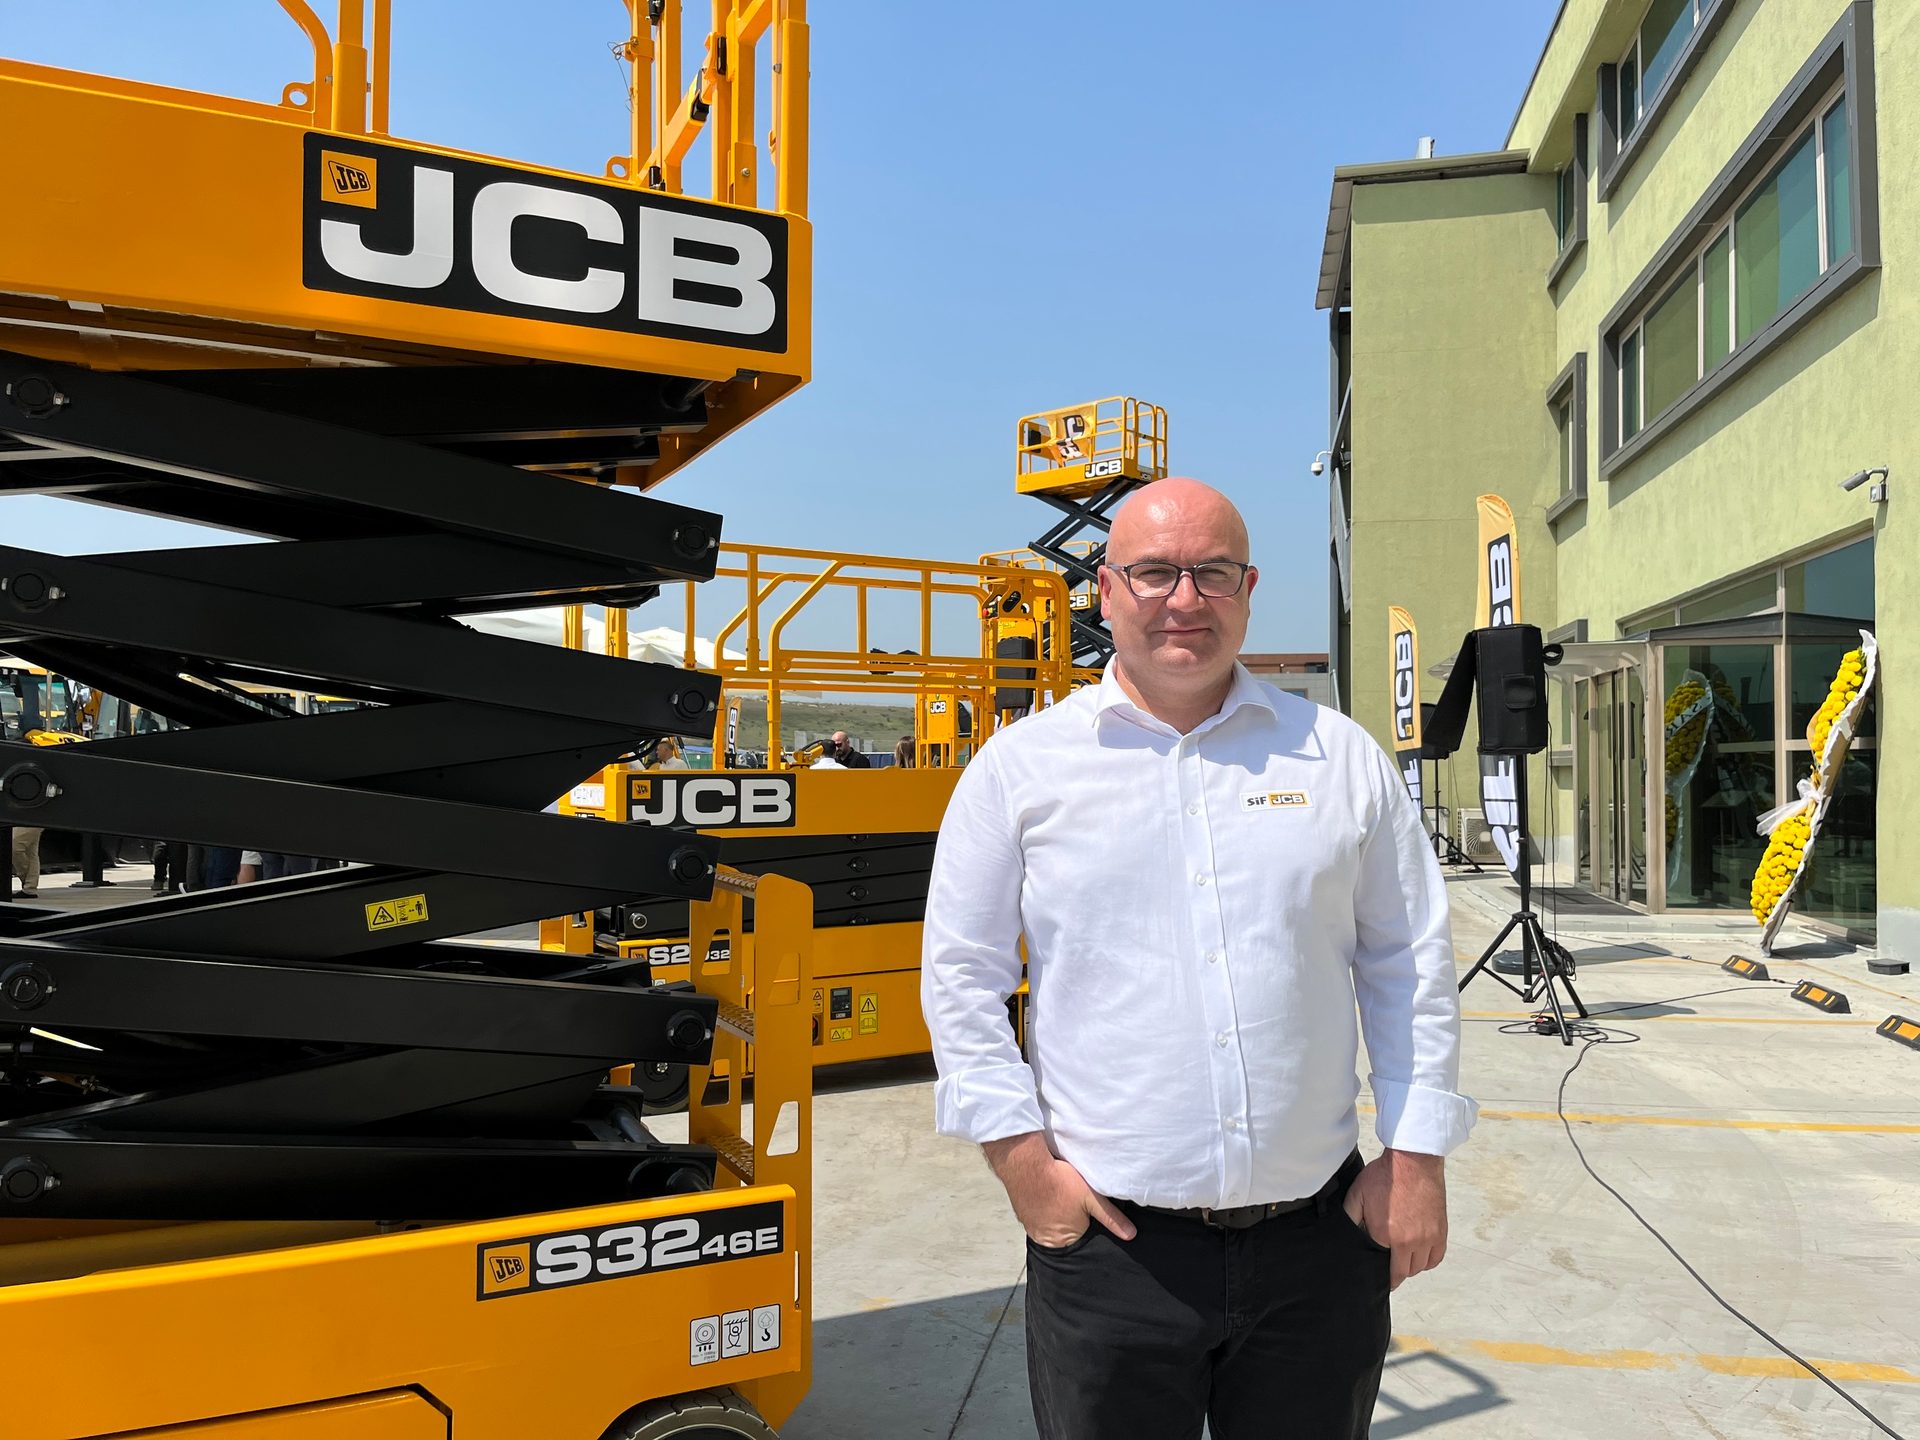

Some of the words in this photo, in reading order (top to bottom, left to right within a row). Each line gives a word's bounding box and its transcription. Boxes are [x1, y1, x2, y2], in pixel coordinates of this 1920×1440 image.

[335, 164, 369, 191] JCB
[320, 165, 776, 335] JCB
[1085, 459, 1122, 478] JCB
[632, 779, 792, 826] JCB
[1246, 796, 1267, 807] SiF
[1272, 794, 1305, 805] JCB
[494, 1258, 523, 1280] JCB
